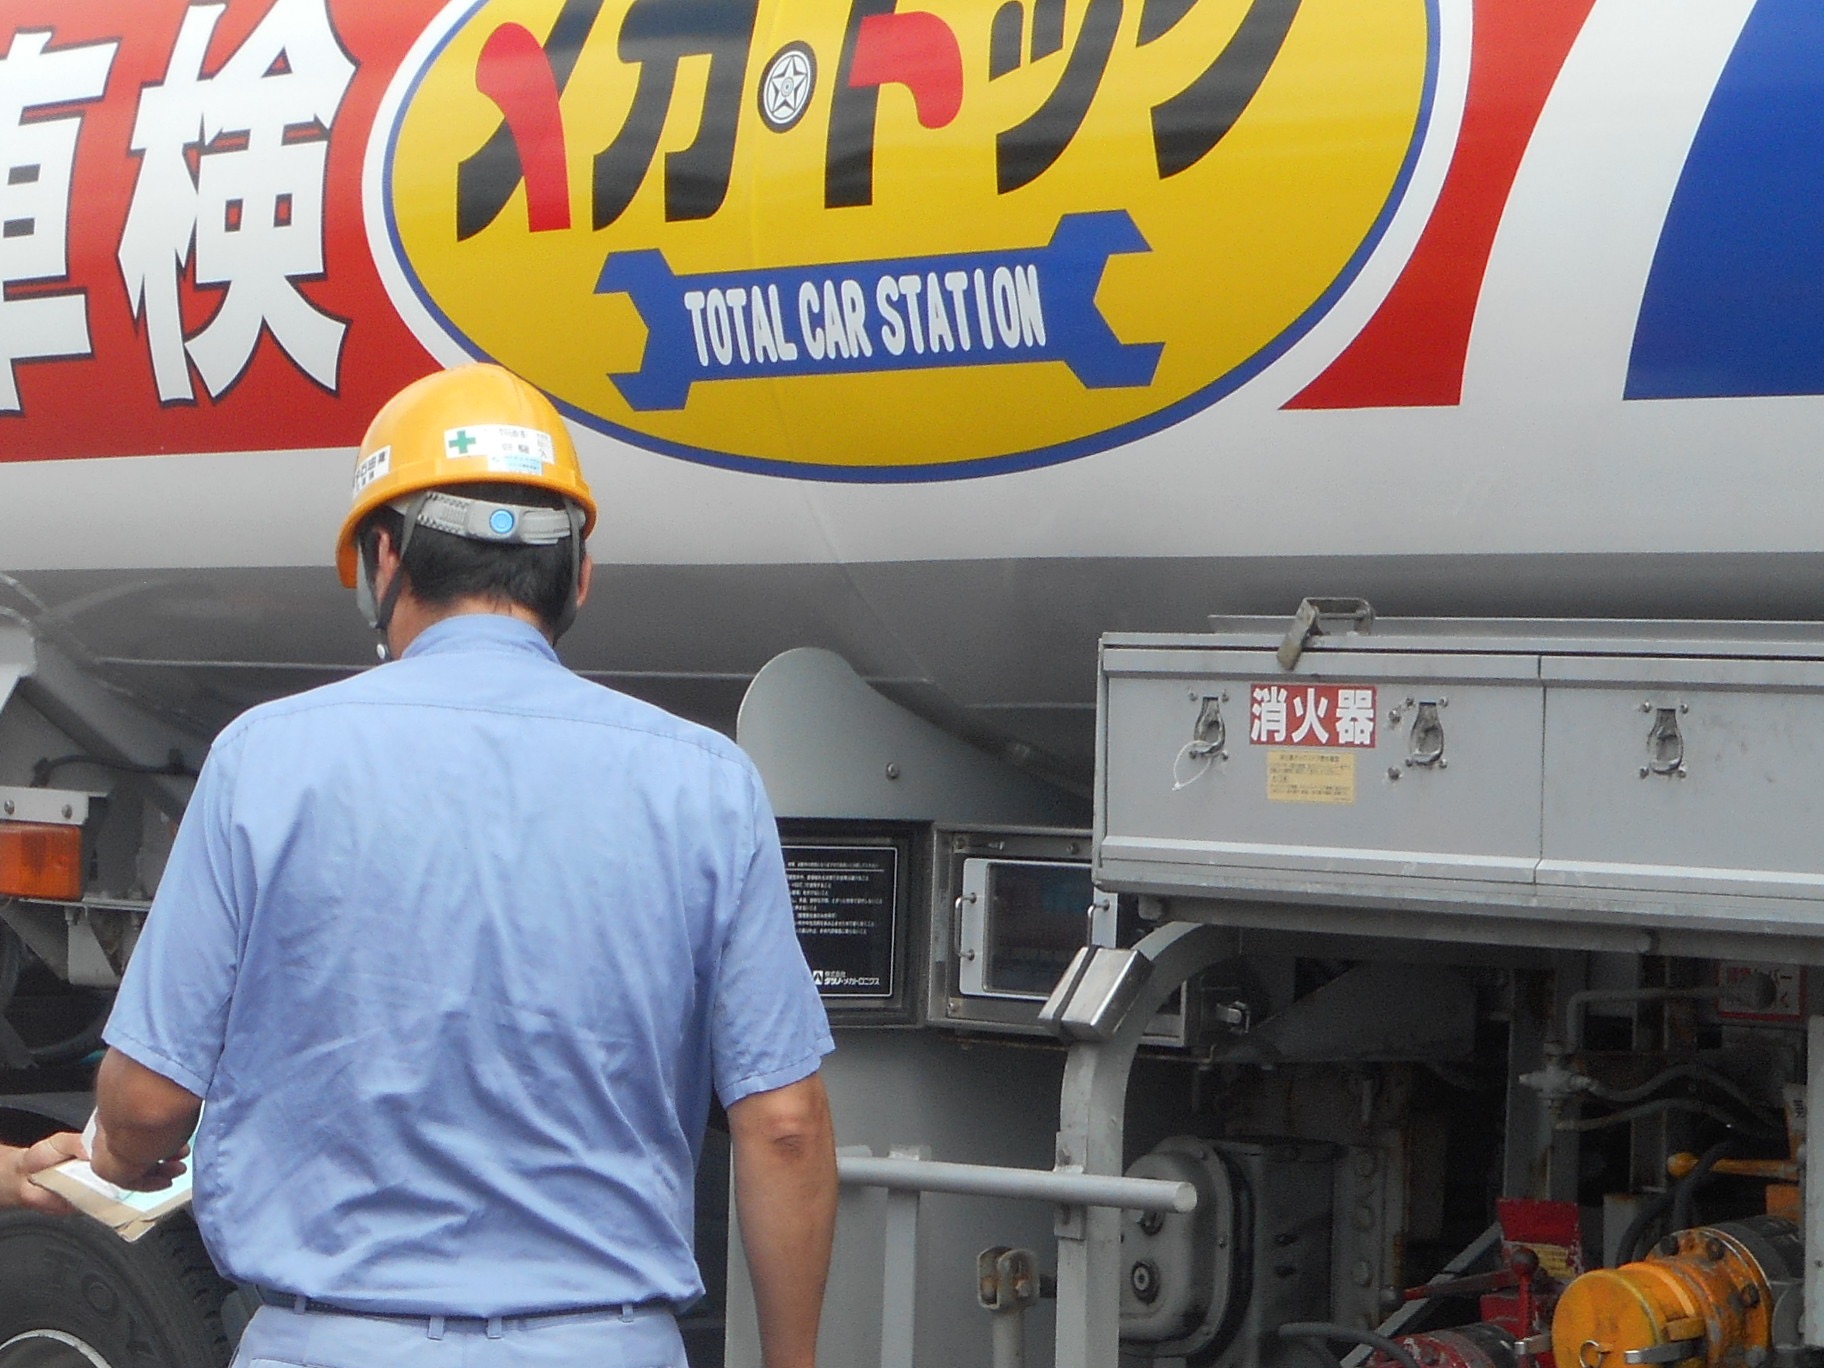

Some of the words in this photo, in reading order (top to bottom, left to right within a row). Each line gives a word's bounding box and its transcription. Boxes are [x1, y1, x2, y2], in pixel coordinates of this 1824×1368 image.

[683, 281, 797, 368] TOTAL
[797, 275, 873, 362] CAR
[876, 263, 1046, 354] STATION
[1250, 686, 1375, 745] 消火器
